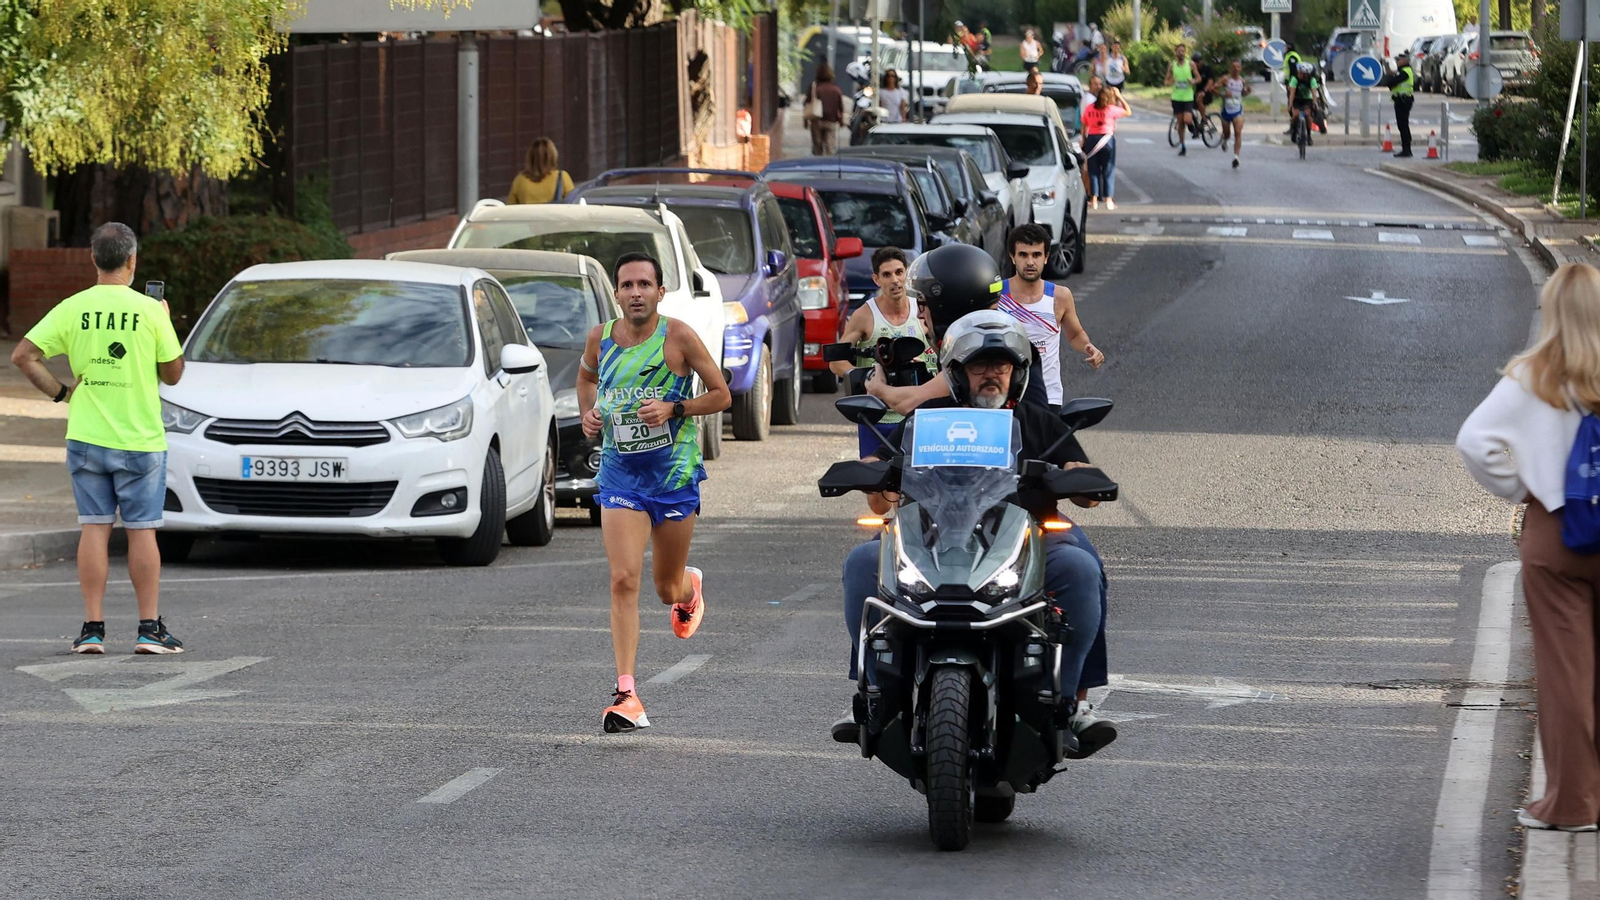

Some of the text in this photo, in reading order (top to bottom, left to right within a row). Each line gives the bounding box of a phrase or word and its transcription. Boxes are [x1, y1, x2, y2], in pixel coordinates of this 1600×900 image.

[81, 311, 140, 331] STAFF
[614, 386, 663, 399] HYGGE
[630, 424, 650, 440] 20
[918, 443, 1005, 454] VEHÍCULO AUTORIZADO
[254, 460, 342, 478] 9393 JSW
